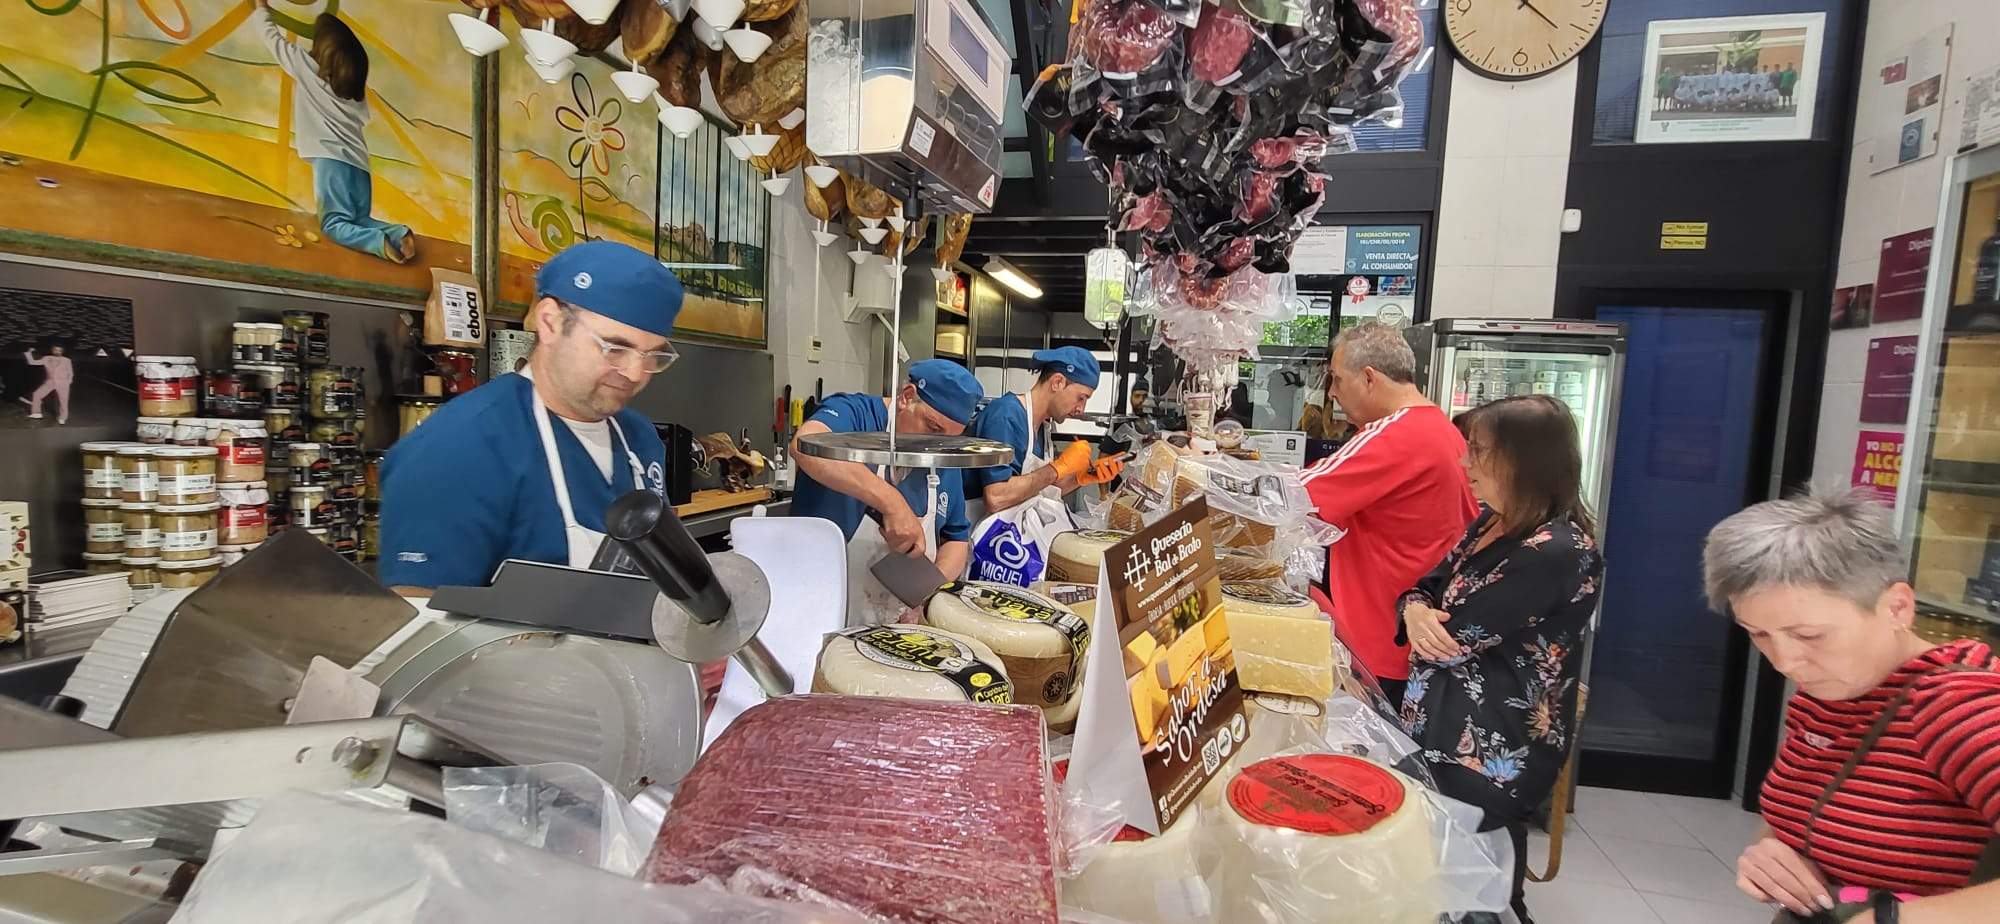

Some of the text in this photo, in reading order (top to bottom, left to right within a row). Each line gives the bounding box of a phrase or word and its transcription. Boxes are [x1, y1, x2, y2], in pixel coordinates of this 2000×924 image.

[1512, 47, 1529, 67] 6
[1361, 262, 1413, 270] AL CONSUMIDOR
[1365, 252, 1411, 260] VENTA DIRECTA
[466, 291, 481, 340] eboca
[1860, 470, 1871, 484] A
[1154, 553, 1171, 577] Bal
[1178, 537, 1202, 561] Broto
[980, 561, 1023, 587] MIGUEL
[1155, 656, 1211, 766] Sabor a
[1177, 665, 1227, 764] Ordesa
